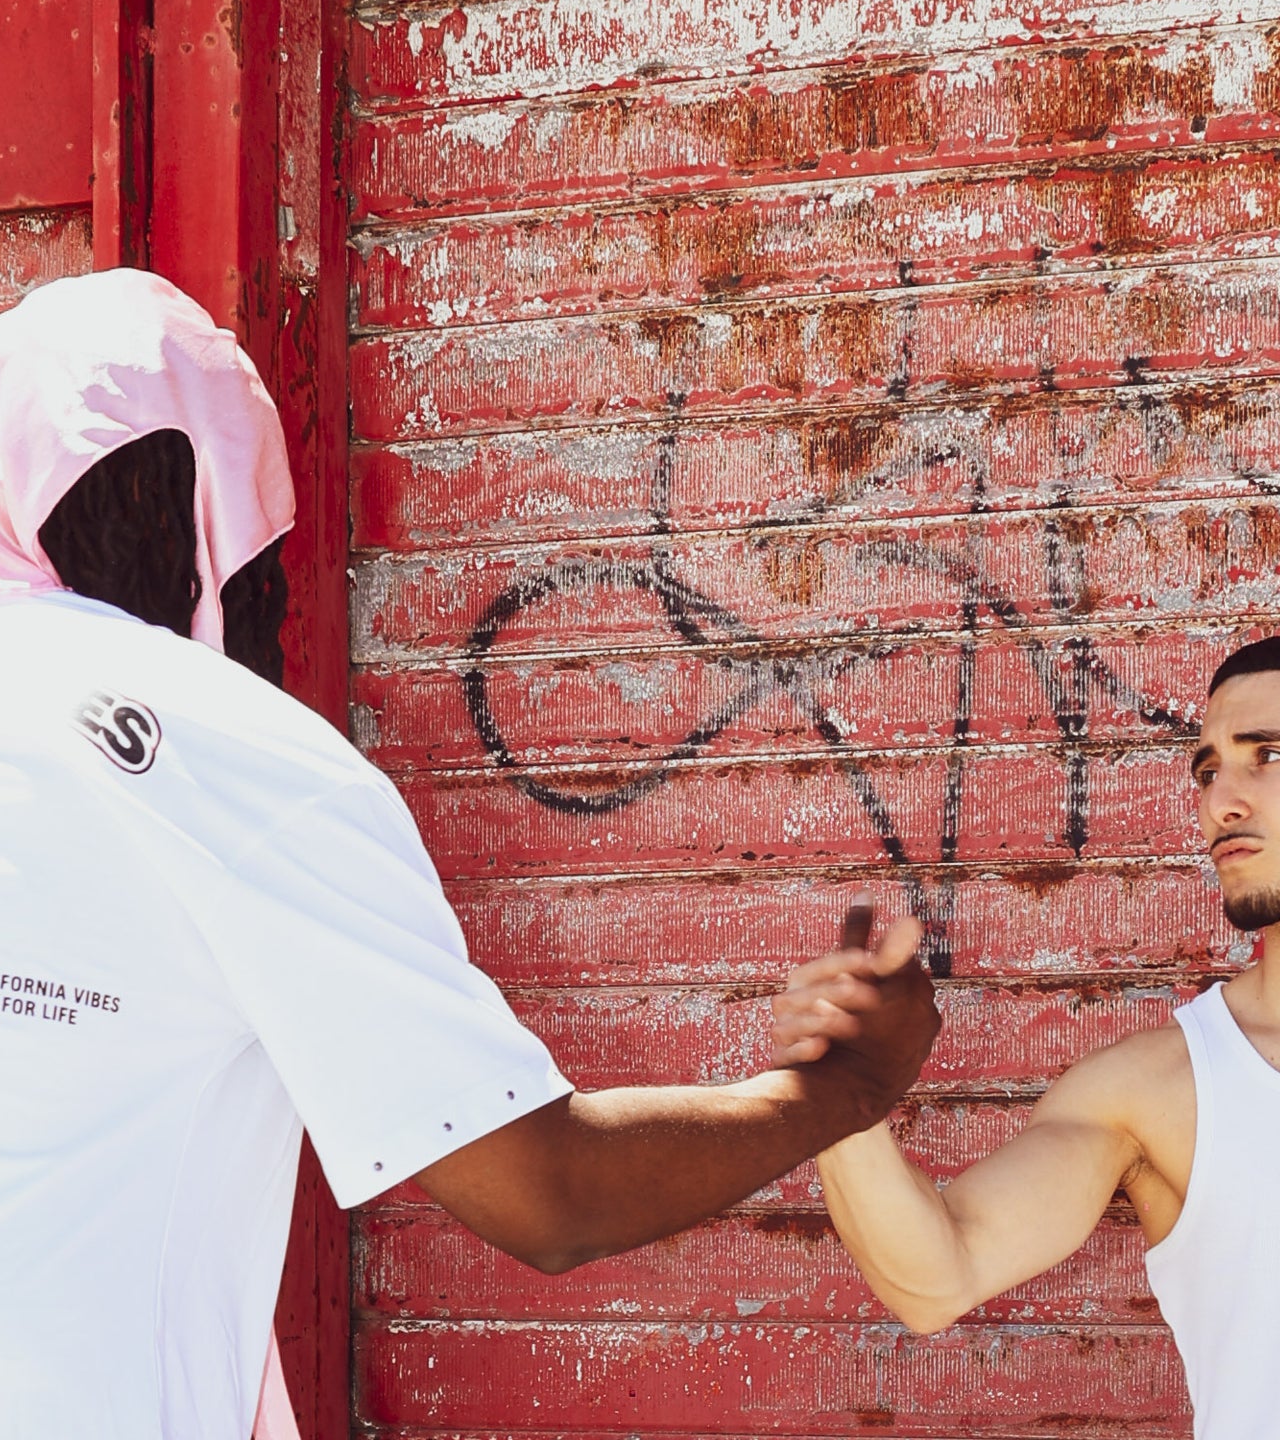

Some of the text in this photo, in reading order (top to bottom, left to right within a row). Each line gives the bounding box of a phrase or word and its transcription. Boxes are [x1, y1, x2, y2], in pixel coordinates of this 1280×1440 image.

[2, 997, 78, 1025] FOR LIFE
[74, 987, 121, 1013] VIBES
